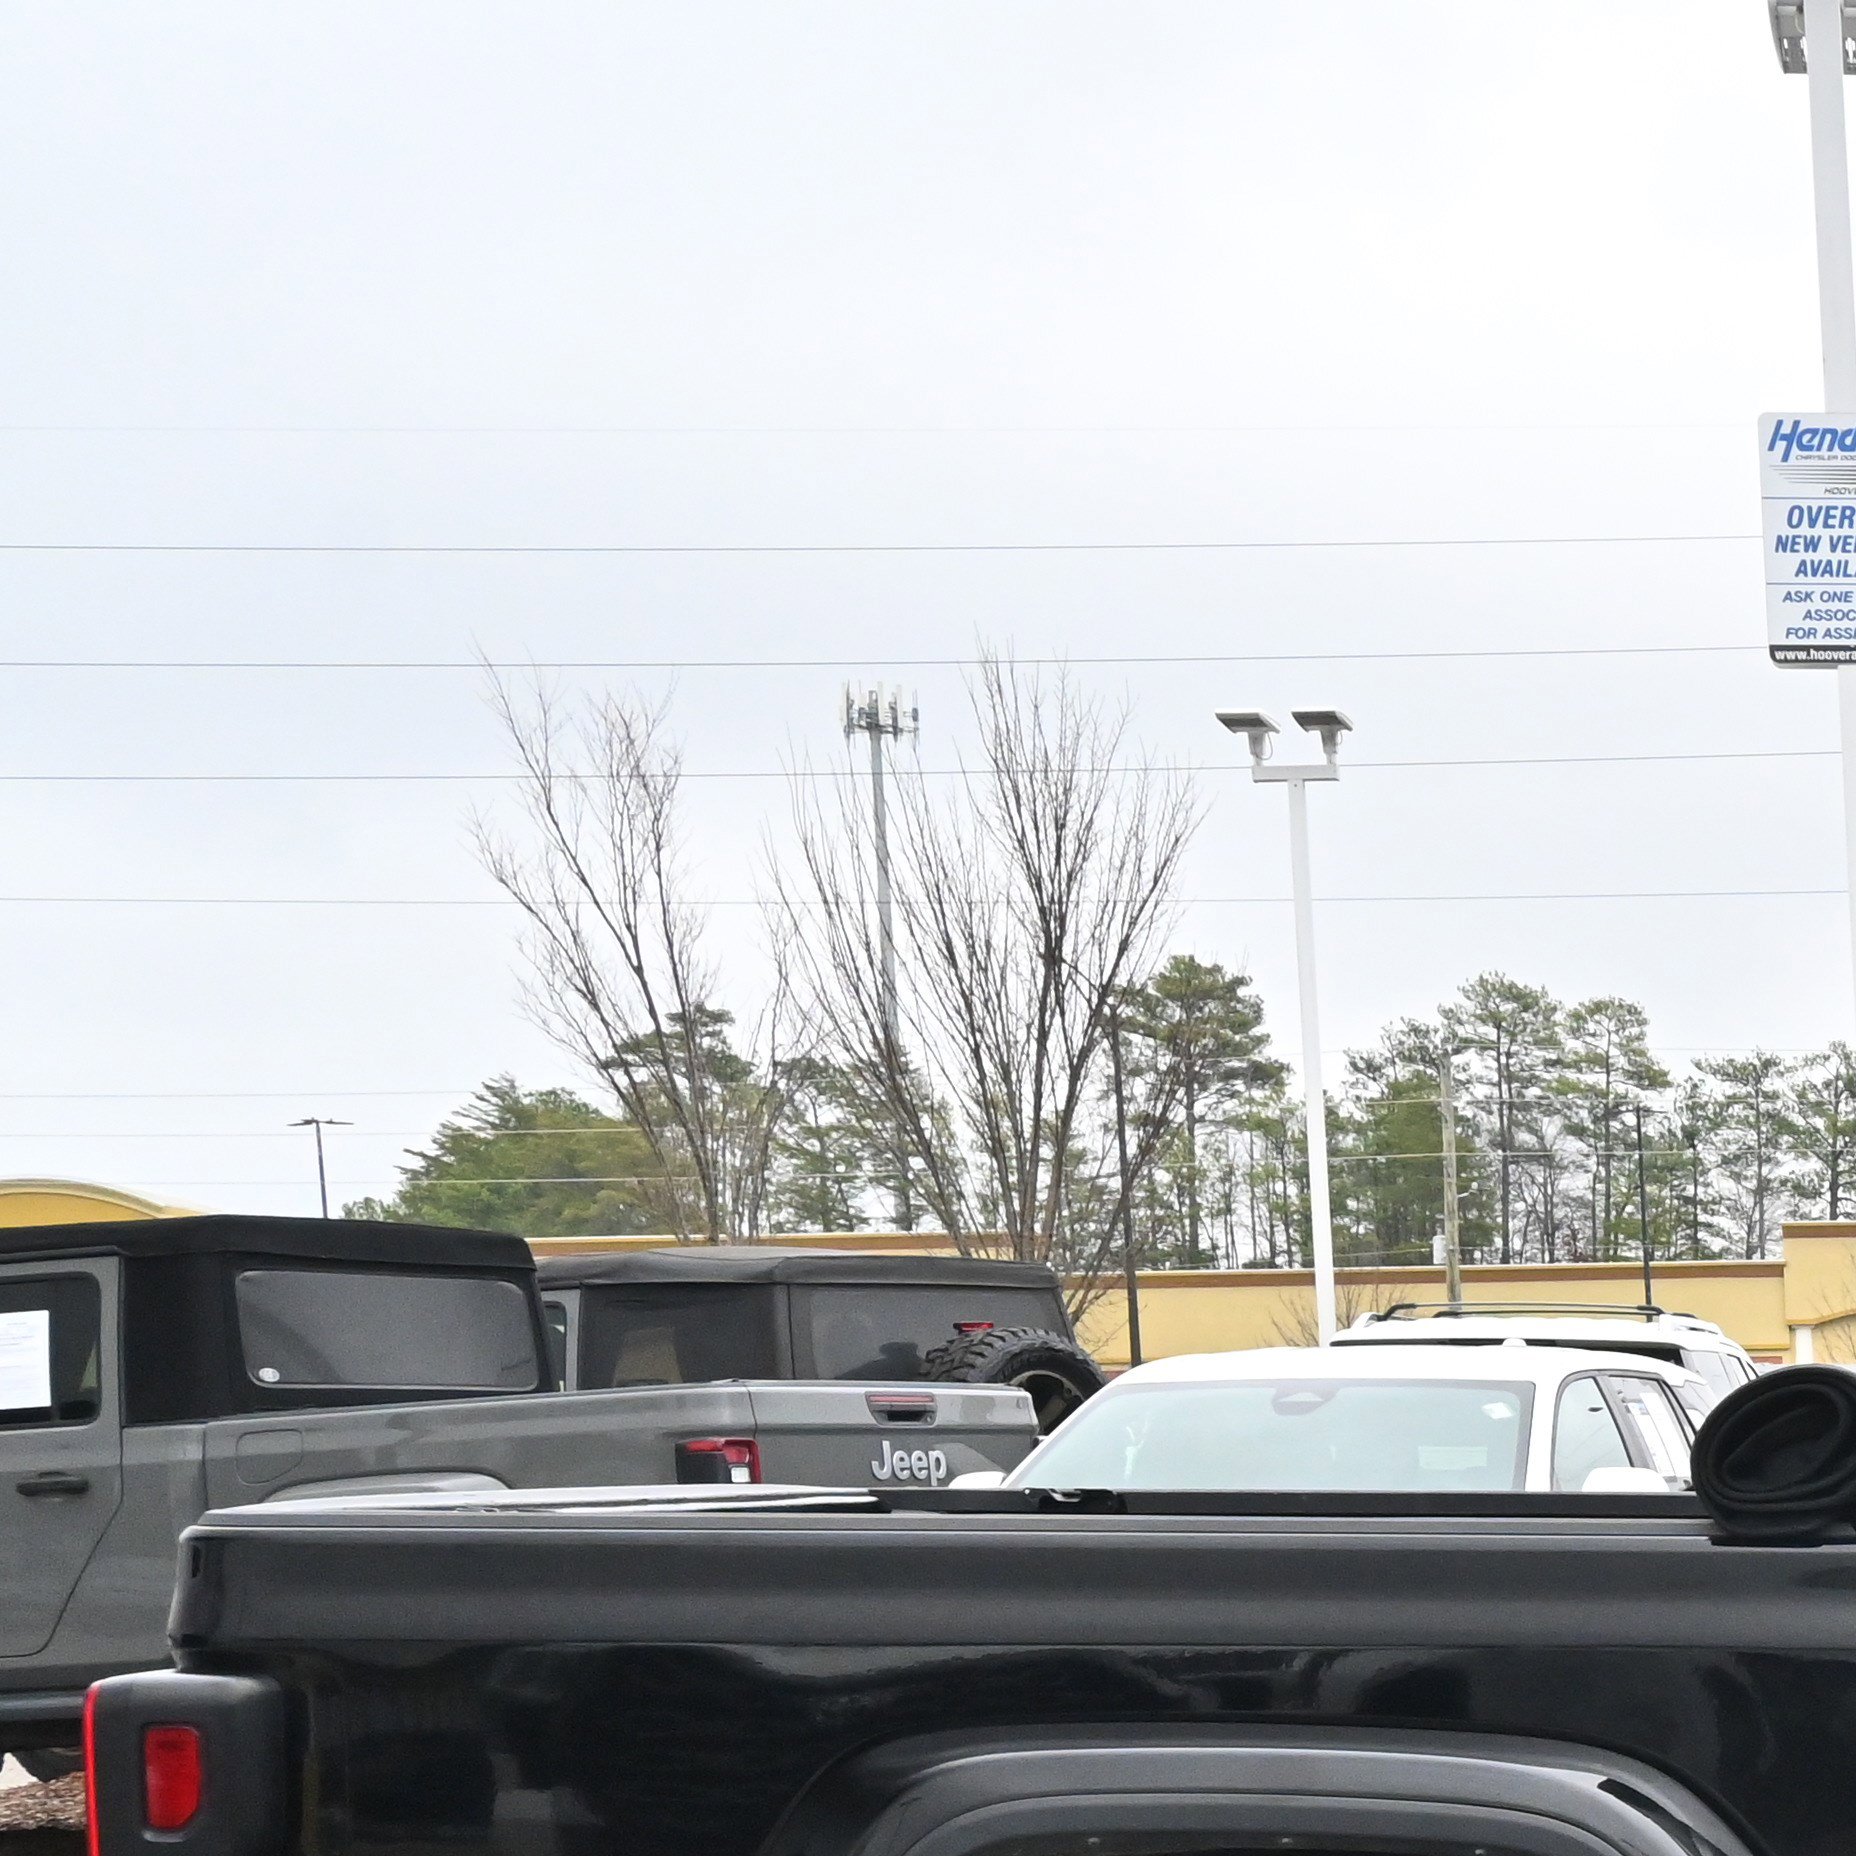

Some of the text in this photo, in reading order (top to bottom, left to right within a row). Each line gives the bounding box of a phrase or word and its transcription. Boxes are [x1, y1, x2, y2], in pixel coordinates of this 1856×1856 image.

[1795, 454, 1838, 462] CHRYSLER
[1786, 504, 1856, 530] OVER
[1774, 534, 1822, 554] NEW
[1782, 590, 1815, 604] ASK
[1819, 590, 1854, 604] ONE
[1785, 626, 1818, 640] FOR
[870, 1440, 947, 1486] Jeep
